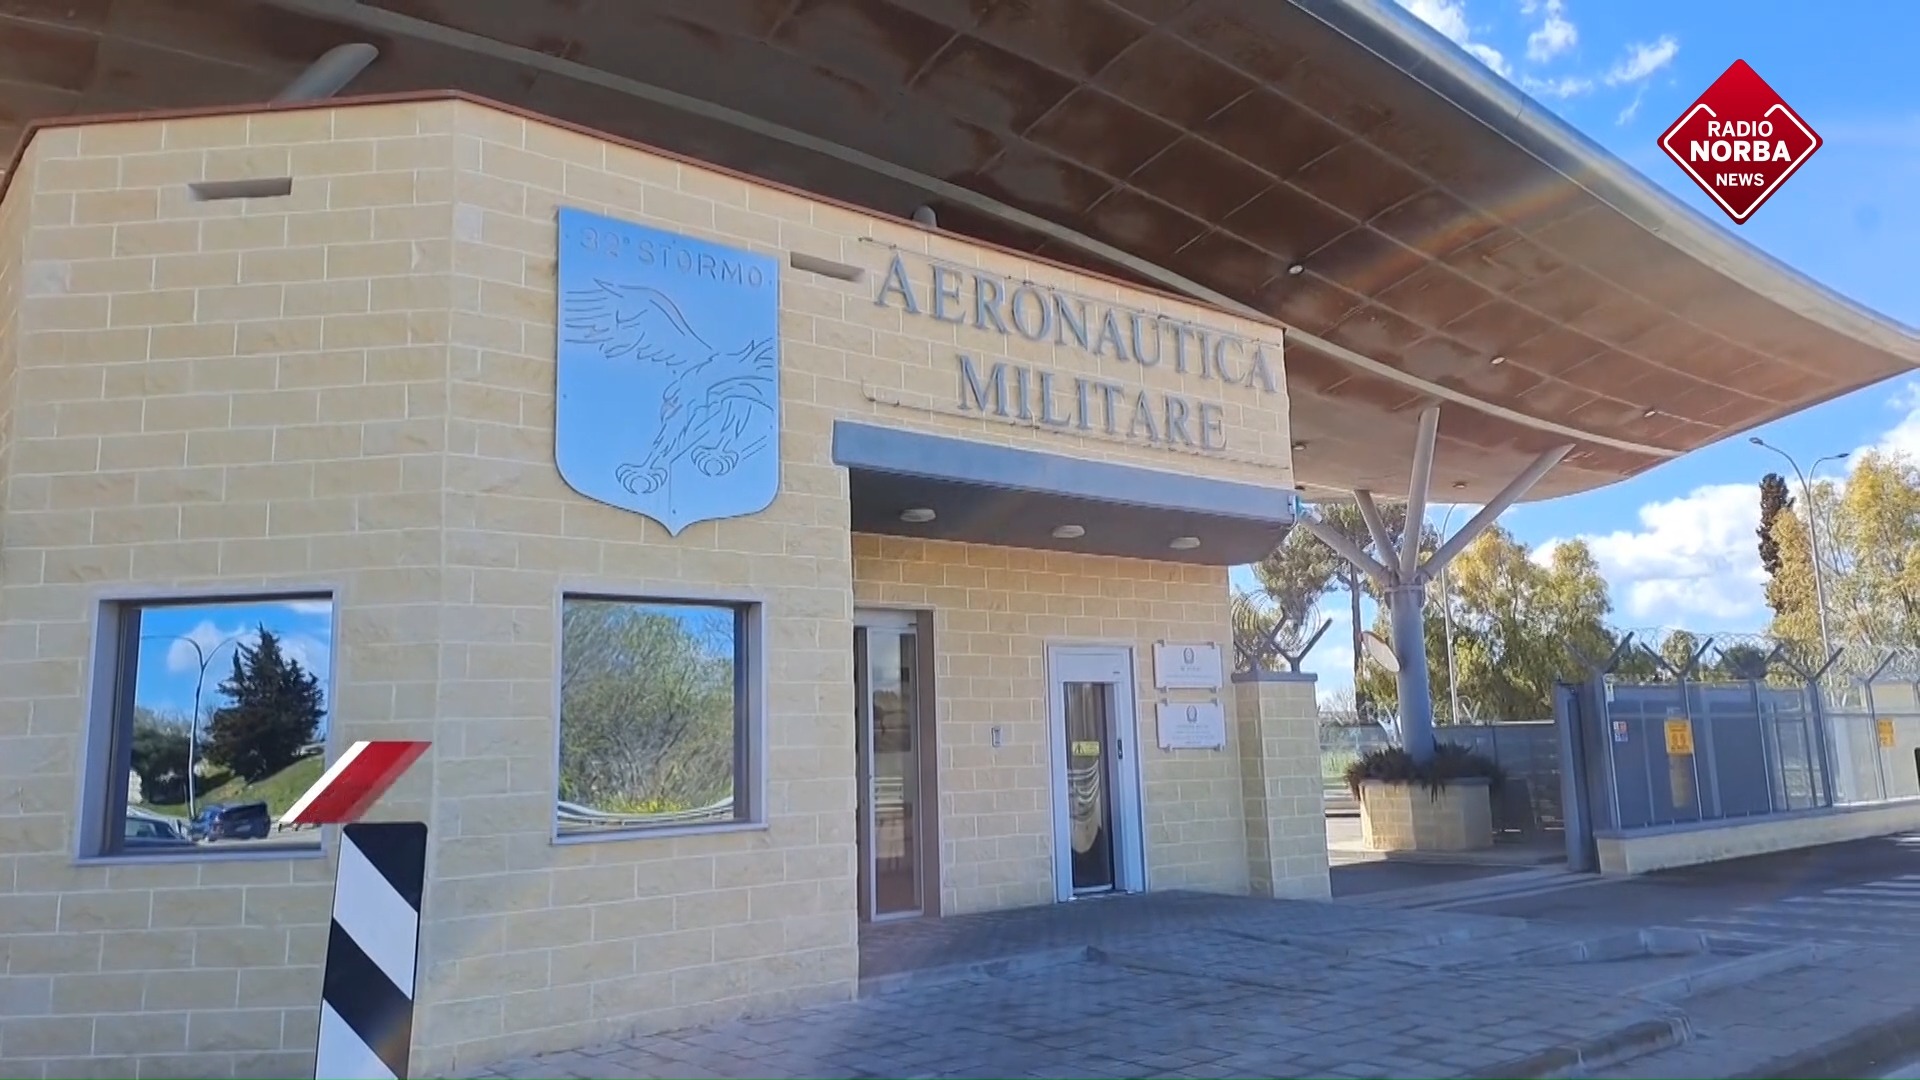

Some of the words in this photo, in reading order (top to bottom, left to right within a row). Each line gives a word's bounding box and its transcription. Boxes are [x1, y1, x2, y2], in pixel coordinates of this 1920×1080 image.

[637, 239, 763, 289] STORMO
[874, 250, 1278, 393] AERONAUTICA
[956, 353, 1228, 452] MILITARE
